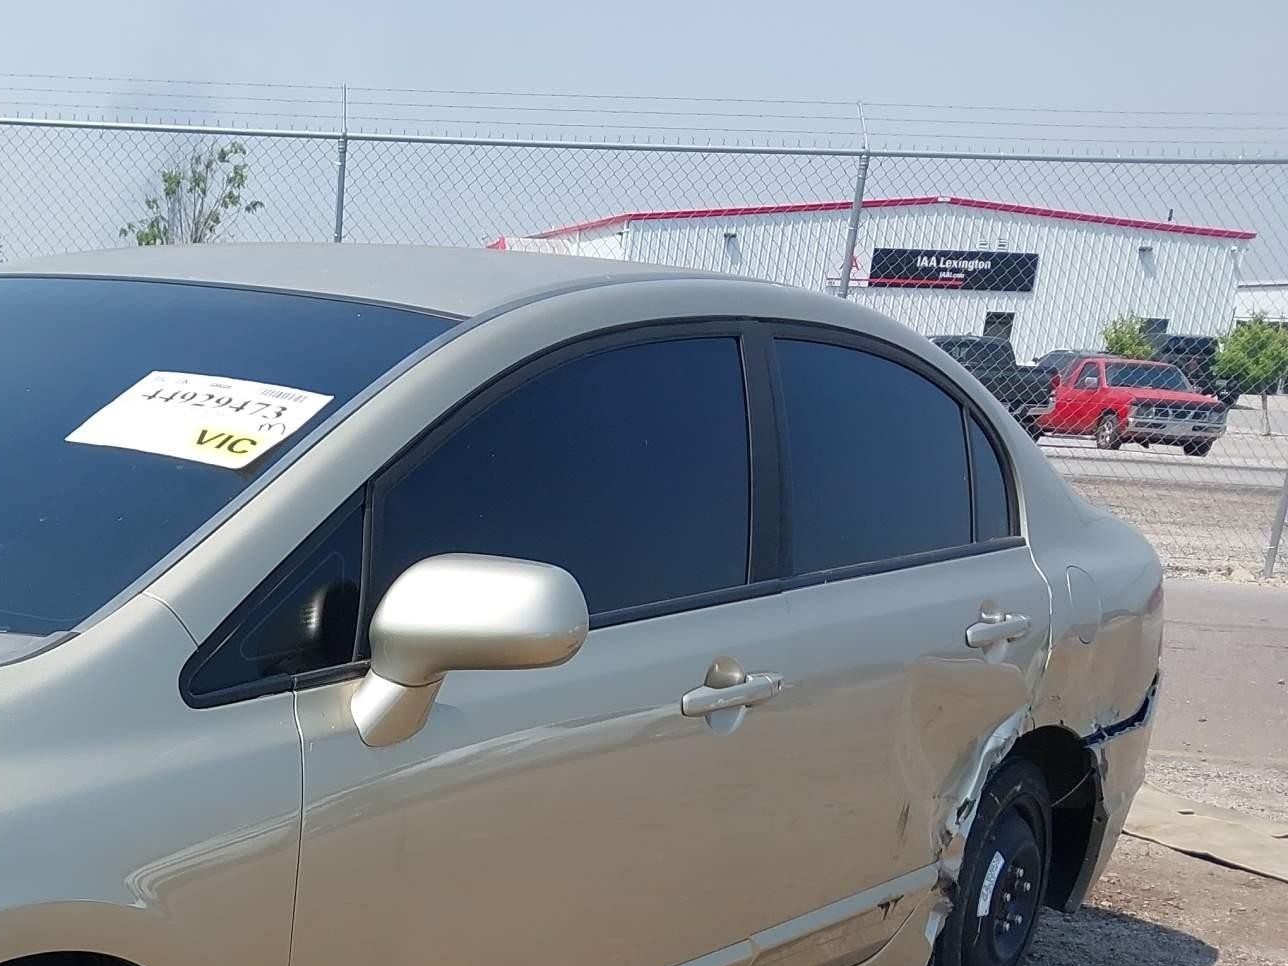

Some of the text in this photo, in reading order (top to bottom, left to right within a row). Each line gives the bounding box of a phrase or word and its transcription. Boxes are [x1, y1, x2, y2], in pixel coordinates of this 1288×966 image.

[916, 255, 992, 271] IAA Lexington
[141, 388, 288, 419] 44929473
[195, 429, 258, 454] VIC
